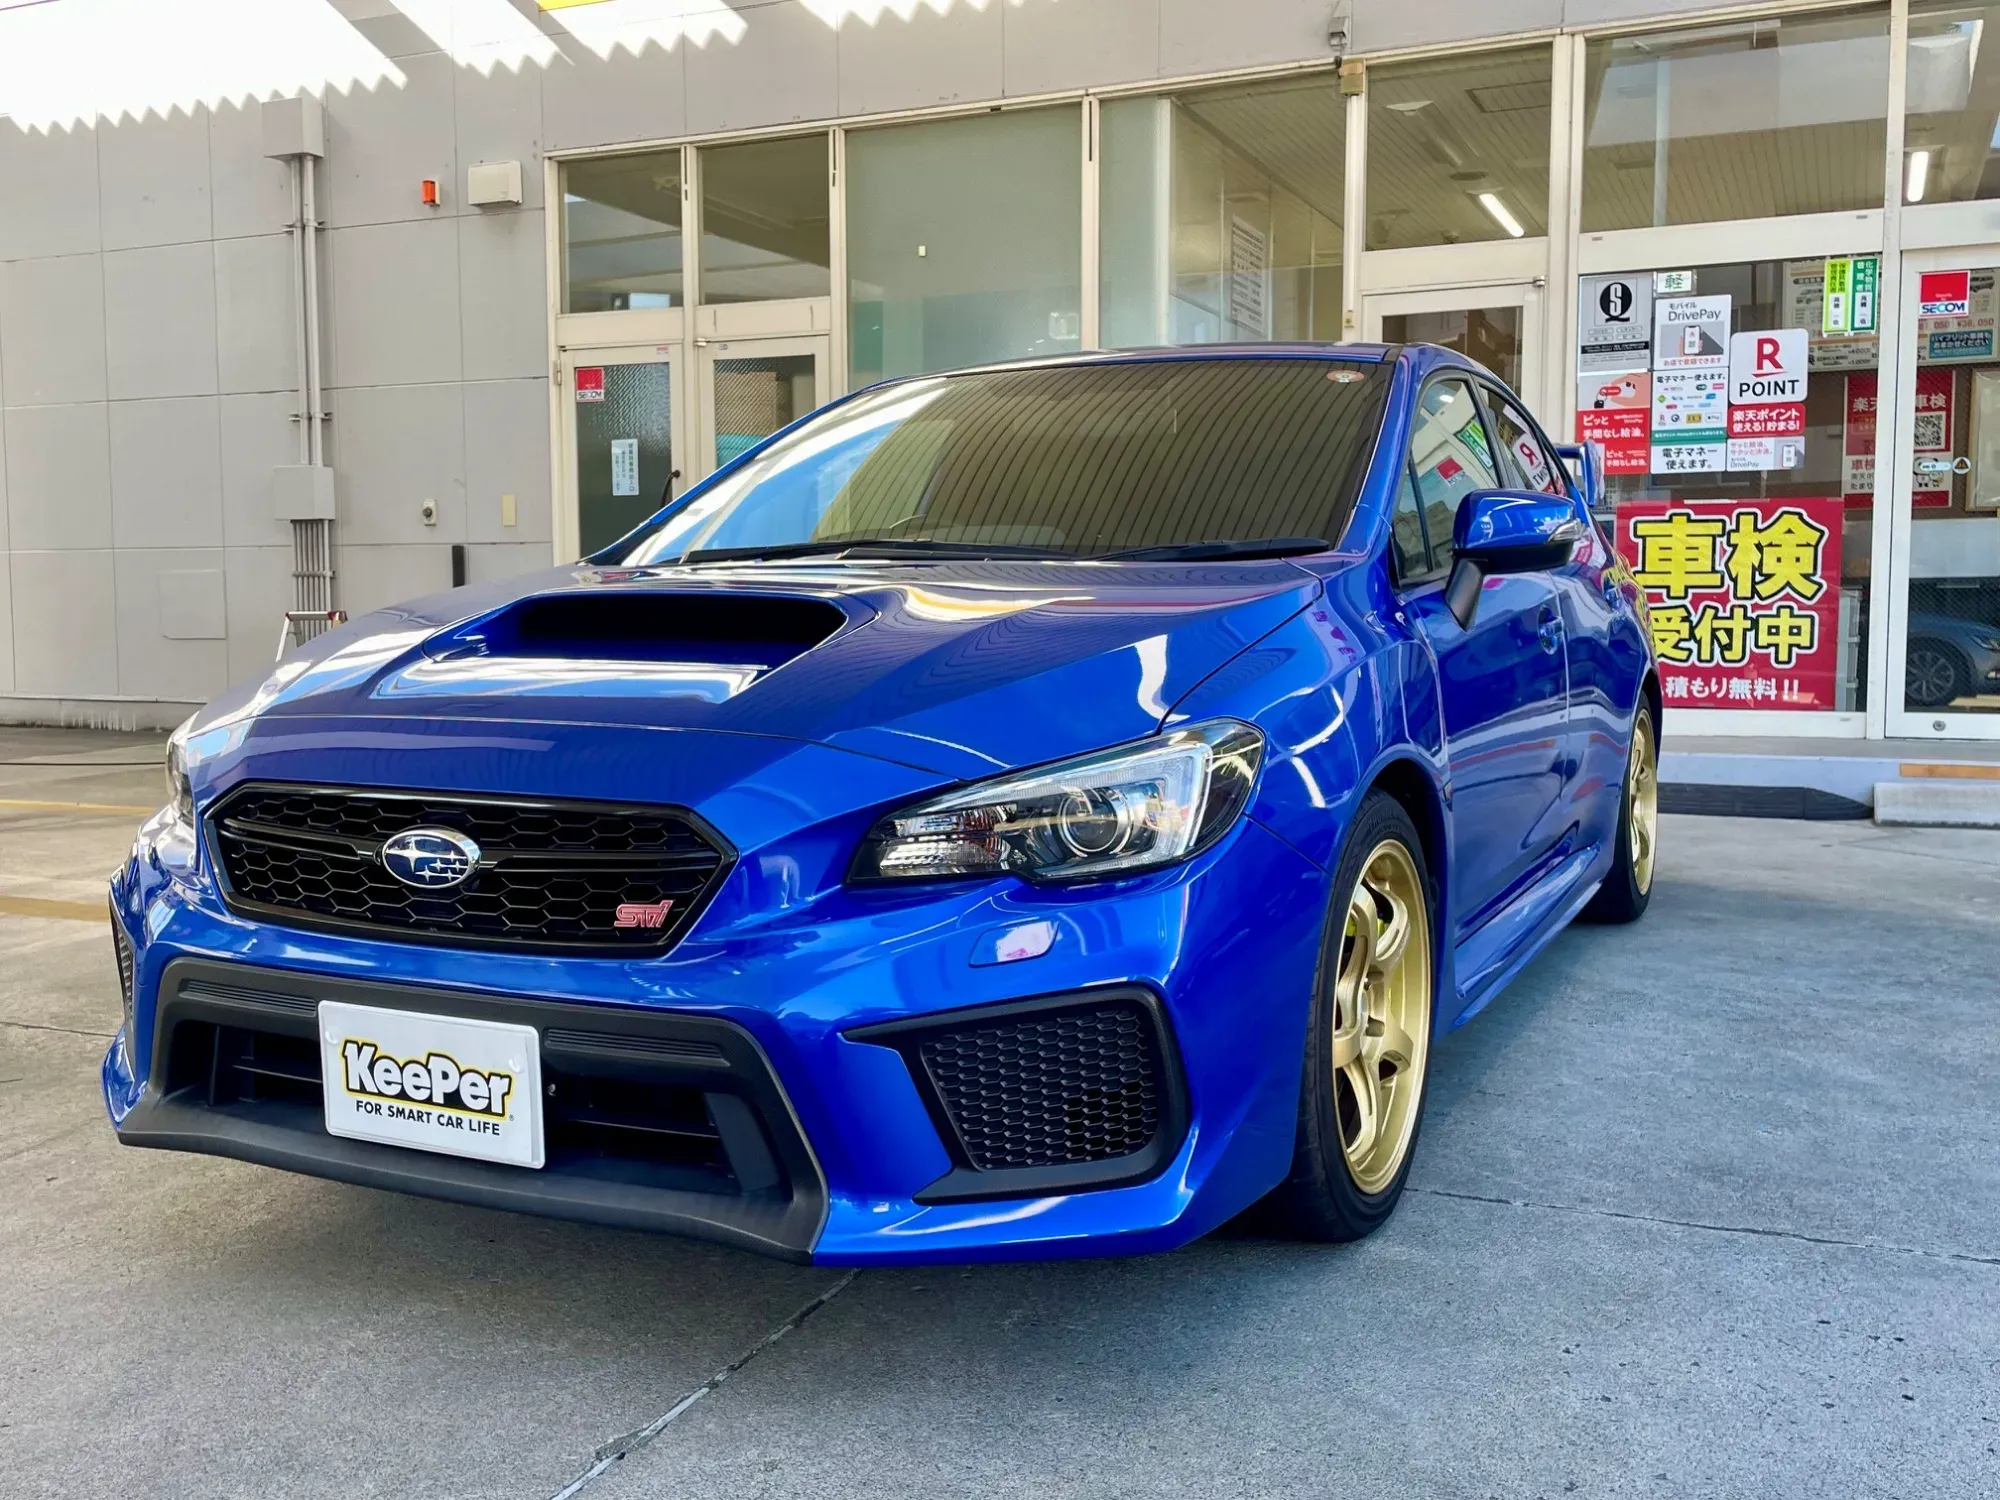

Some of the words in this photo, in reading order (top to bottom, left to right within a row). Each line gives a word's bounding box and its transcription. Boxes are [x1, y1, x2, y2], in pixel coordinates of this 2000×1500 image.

[1668, 308, 1721, 322] DrivePay
[1922, 302, 1965, 314] SECOM
[1756, 338, 1784, 371] R
[1663, 357, 1721, 367] お店で登録できます
[1656, 373, 1725, 384] 電子マネー使えます。
[1739, 380, 1800, 398] POINT
[1583, 414, 1609, 427] ピッと
[1733, 408, 1800, 422] 楽天ポイント
[1662, 447, 1718, 458] 電子マネー
[1665, 459, 1712, 470] 使えます。
[1632, 510, 1827, 602] 車検
[1650, 603, 1817, 665] 受付中
[1661, 676, 1800, 701] 積もり無料!!
[342, 1039, 512, 1118] KeePer
[356, 1099, 383, 1117] FOR
[387, 1105, 432, 1125] SMART
[436, 1113, 464, 1131] CAR
[468, 1120, 501, 1136] LIFE
